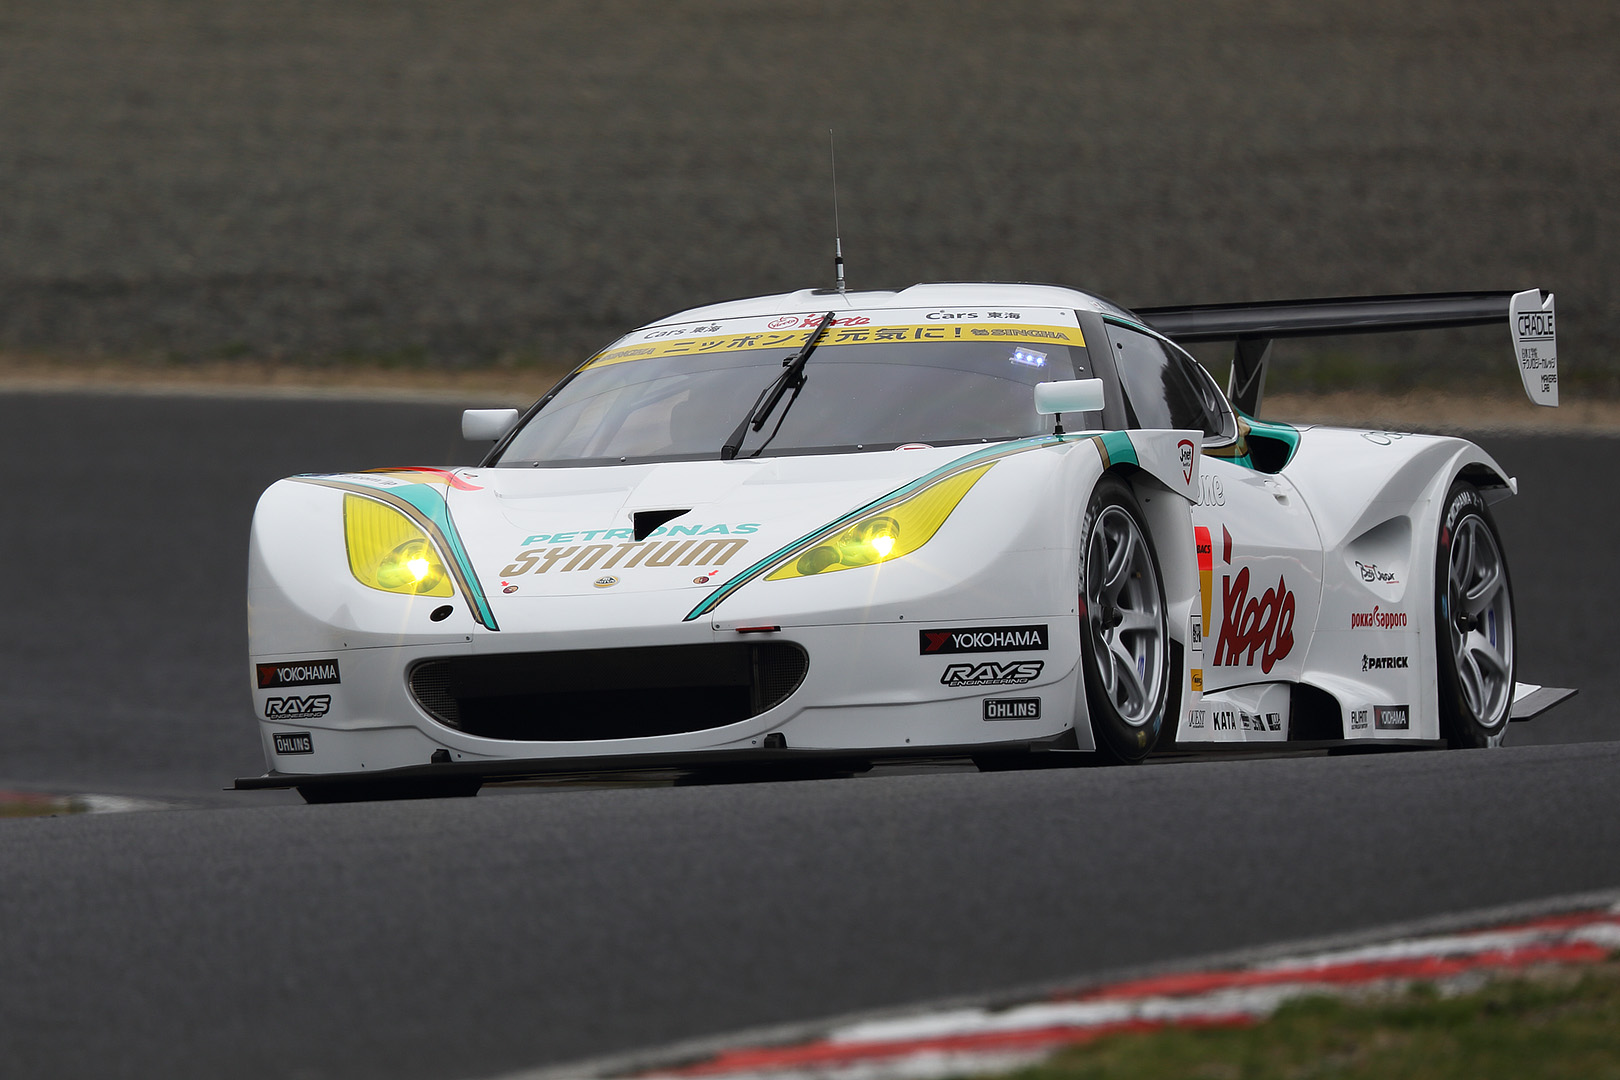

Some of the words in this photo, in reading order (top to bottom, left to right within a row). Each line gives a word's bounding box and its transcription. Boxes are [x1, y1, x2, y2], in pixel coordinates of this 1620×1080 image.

[926, 311, 979, 320] Cars
[987, 311, 1021, 320] 東海
[644, 328, 687, 340] Cars
[1518, 315, 1554, 336] CRADLE
[990, 328, 1070, 341] SINGHA
[1197, 544, 1211, 554] BACS
[499, 538, 749, 578] SYNTIUM
[951, 630, 1042, 648] YOKOHAMA
[1368, 656, 1409, 669] PATRICK
[277, 664, 337, 682] YOKOHAMA
[942, 661, 1043, 682] RAYS
[949, 678, 1029, 687] ENGINEERING
[265, 695, 331, 716] RAYS
[988, 701, 1037, 718] ÖHLINS
[270, 712, 323, 720] ENGINEERING
[1213, 711, 1237, 731] KATA
[276, 735, 311, 752] ÖHLINS
